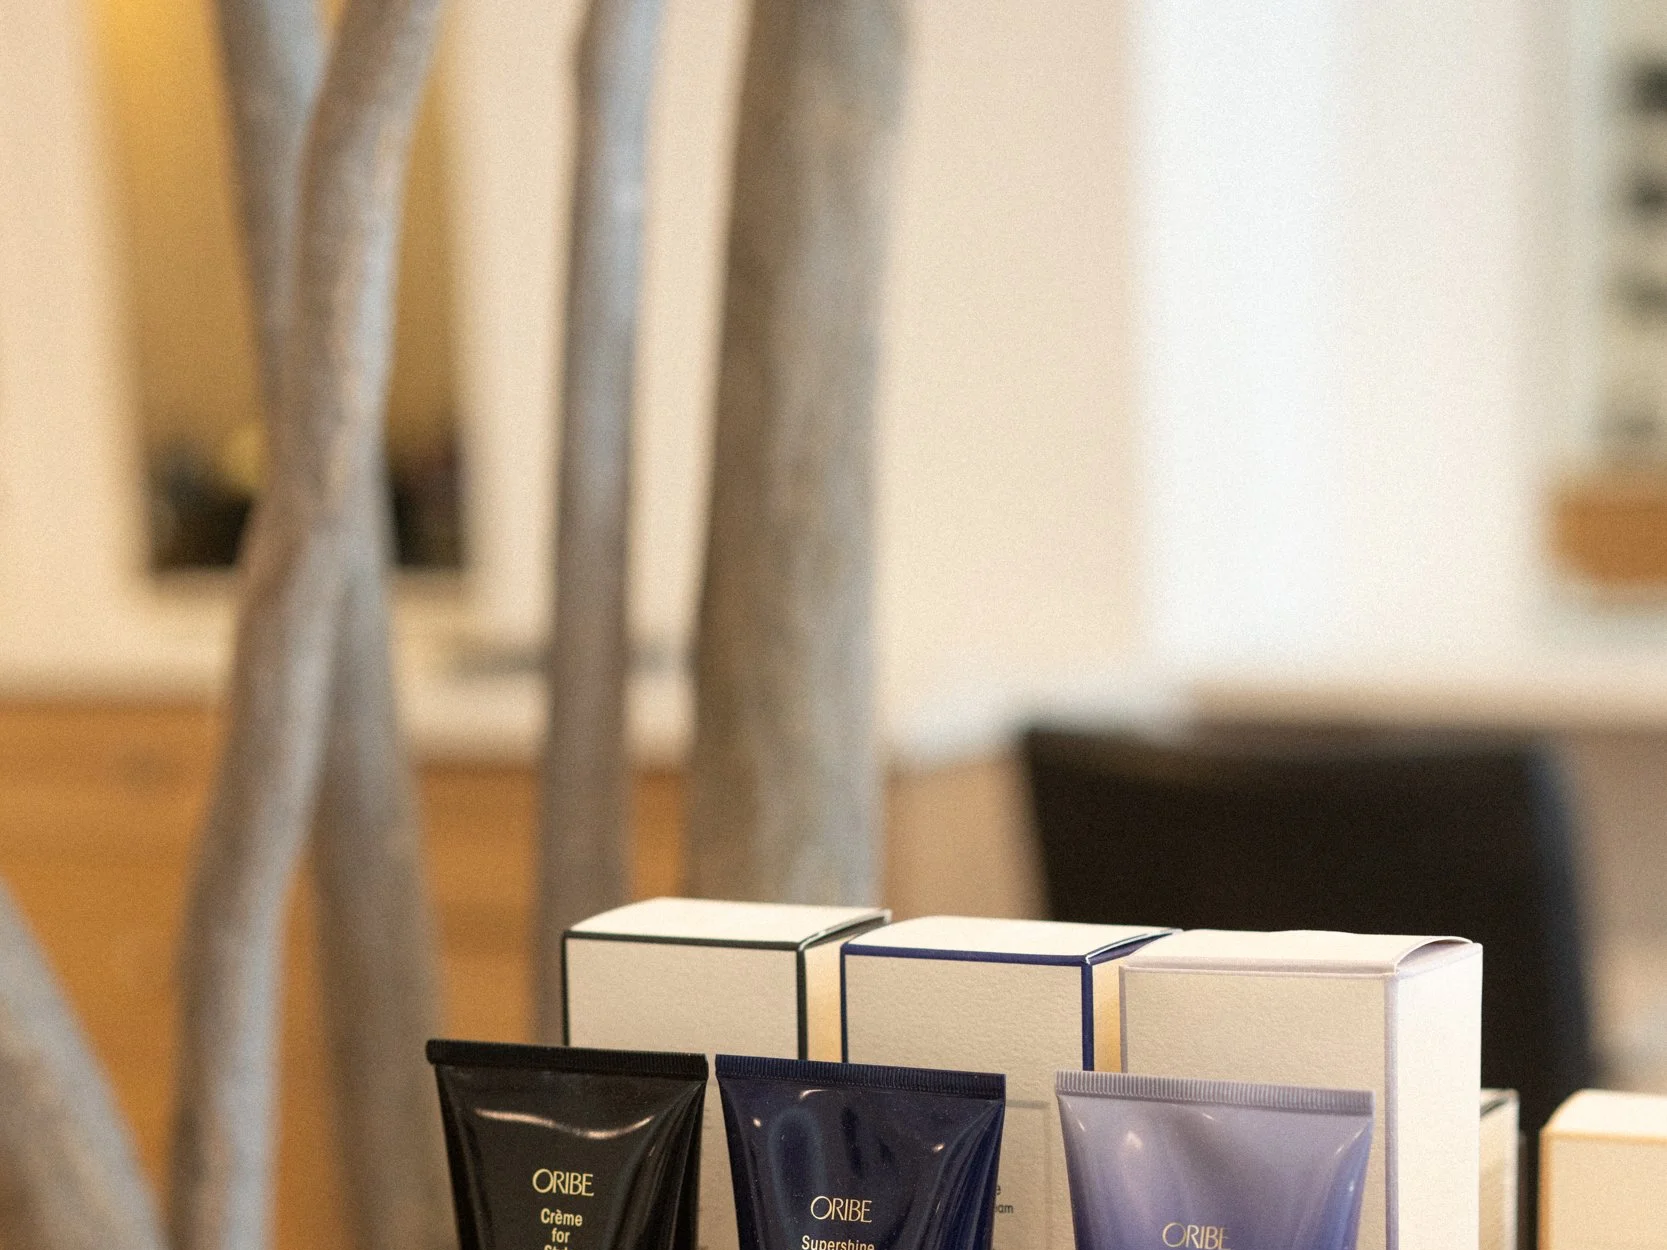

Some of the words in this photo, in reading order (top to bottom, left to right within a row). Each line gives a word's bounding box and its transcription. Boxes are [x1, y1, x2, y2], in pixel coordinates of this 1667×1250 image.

[532, 1168, 594, 1197] ORIBE
[540, 1207, 583, 1227] Crème
[810, 1195, 873, 1223] ORIBE
[551, 1228, 570, 1243] for
[1162, 1222, 1231, 1250] ORIBE
